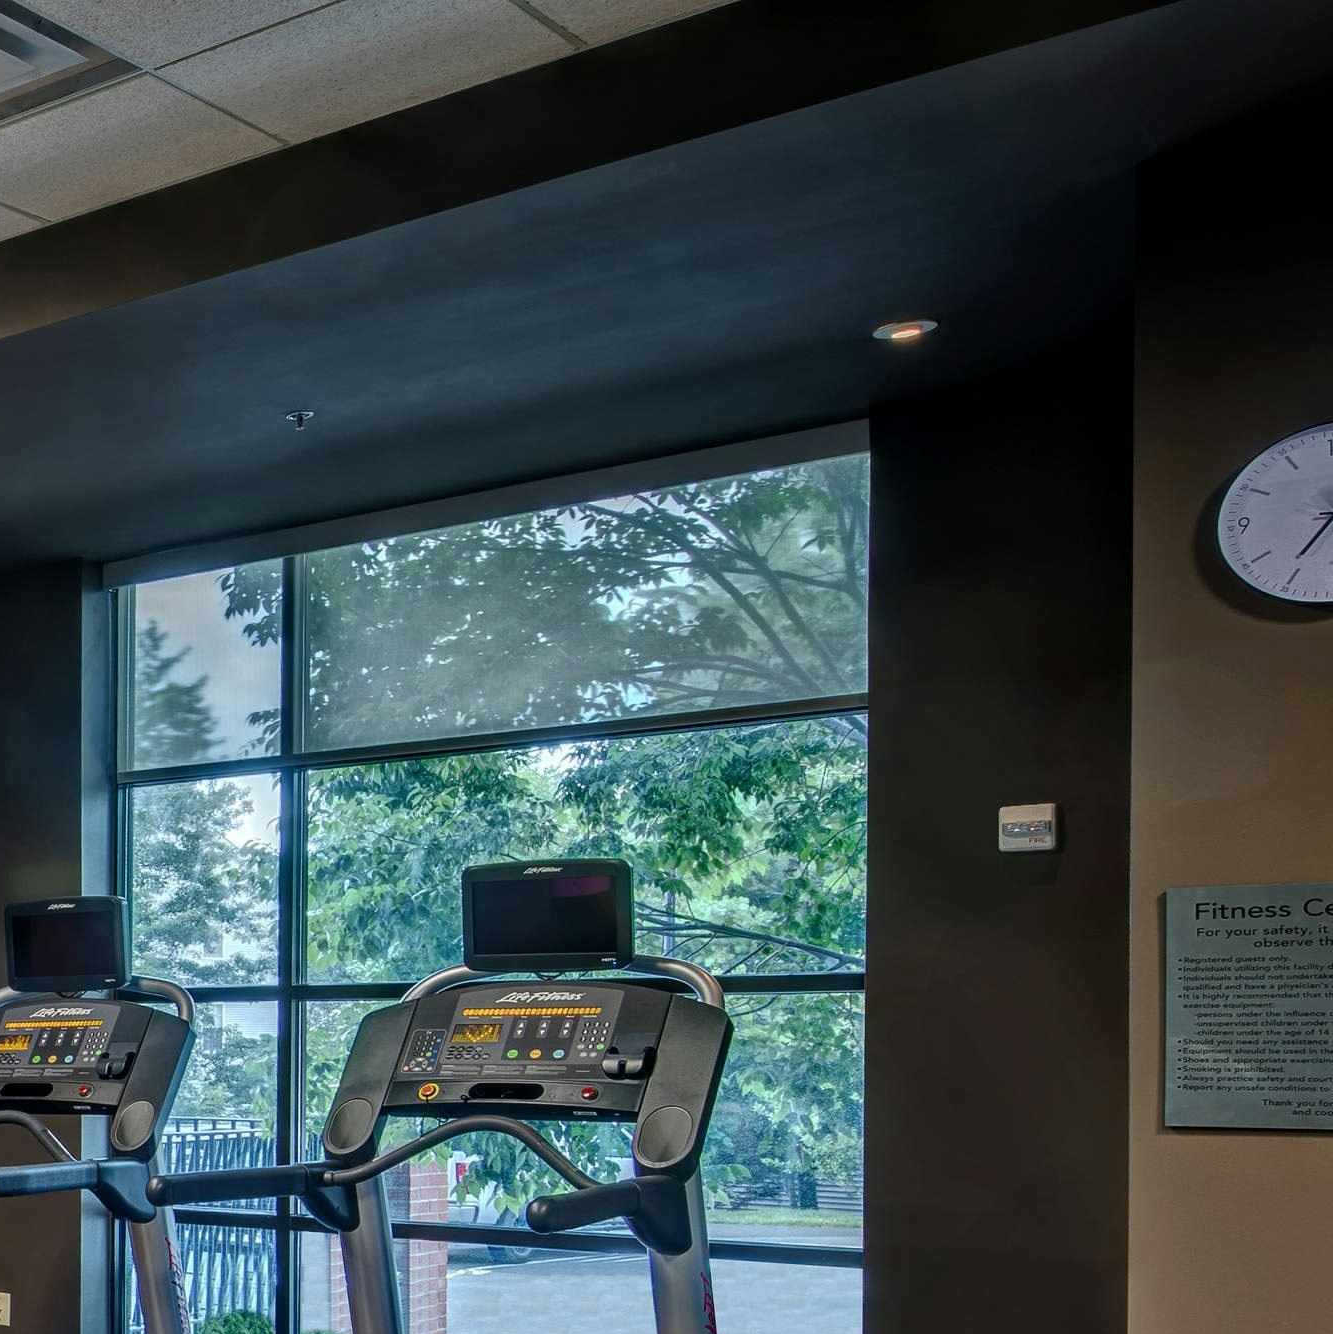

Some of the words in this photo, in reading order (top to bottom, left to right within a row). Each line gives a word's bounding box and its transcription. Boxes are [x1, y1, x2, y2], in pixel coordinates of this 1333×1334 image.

[1238, 516, 1250, 535] 9
[1195, 902, 1291, 920] Fitness
[1196, 927, 1220, 937] For
[1225, 928, 1257, 939] your
[1263, 925, 1312, 937] safety,
[1318, 924, 1328, 934] it
[1253, 937, 1313, 948] observe
